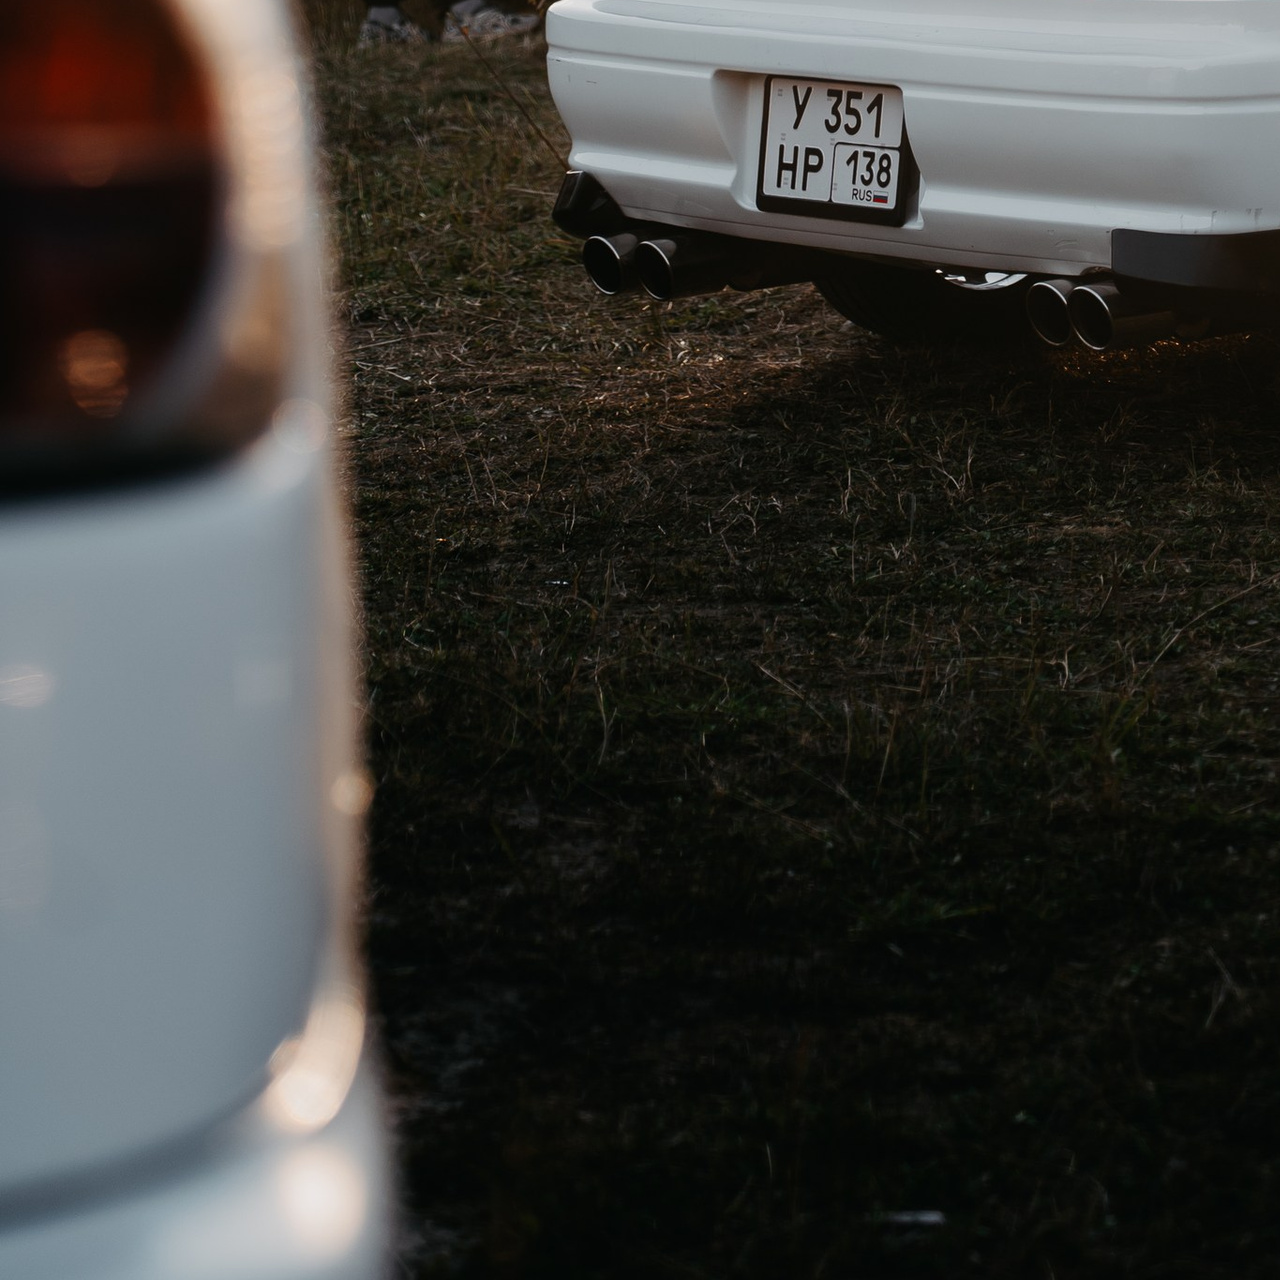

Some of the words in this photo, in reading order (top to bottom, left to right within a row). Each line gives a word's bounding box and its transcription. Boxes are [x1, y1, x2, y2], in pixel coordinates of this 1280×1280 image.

[824, 88, 884, 138] 351
[845, 149, 892, 189] 138
[851, 188, 873, 202] RUS
